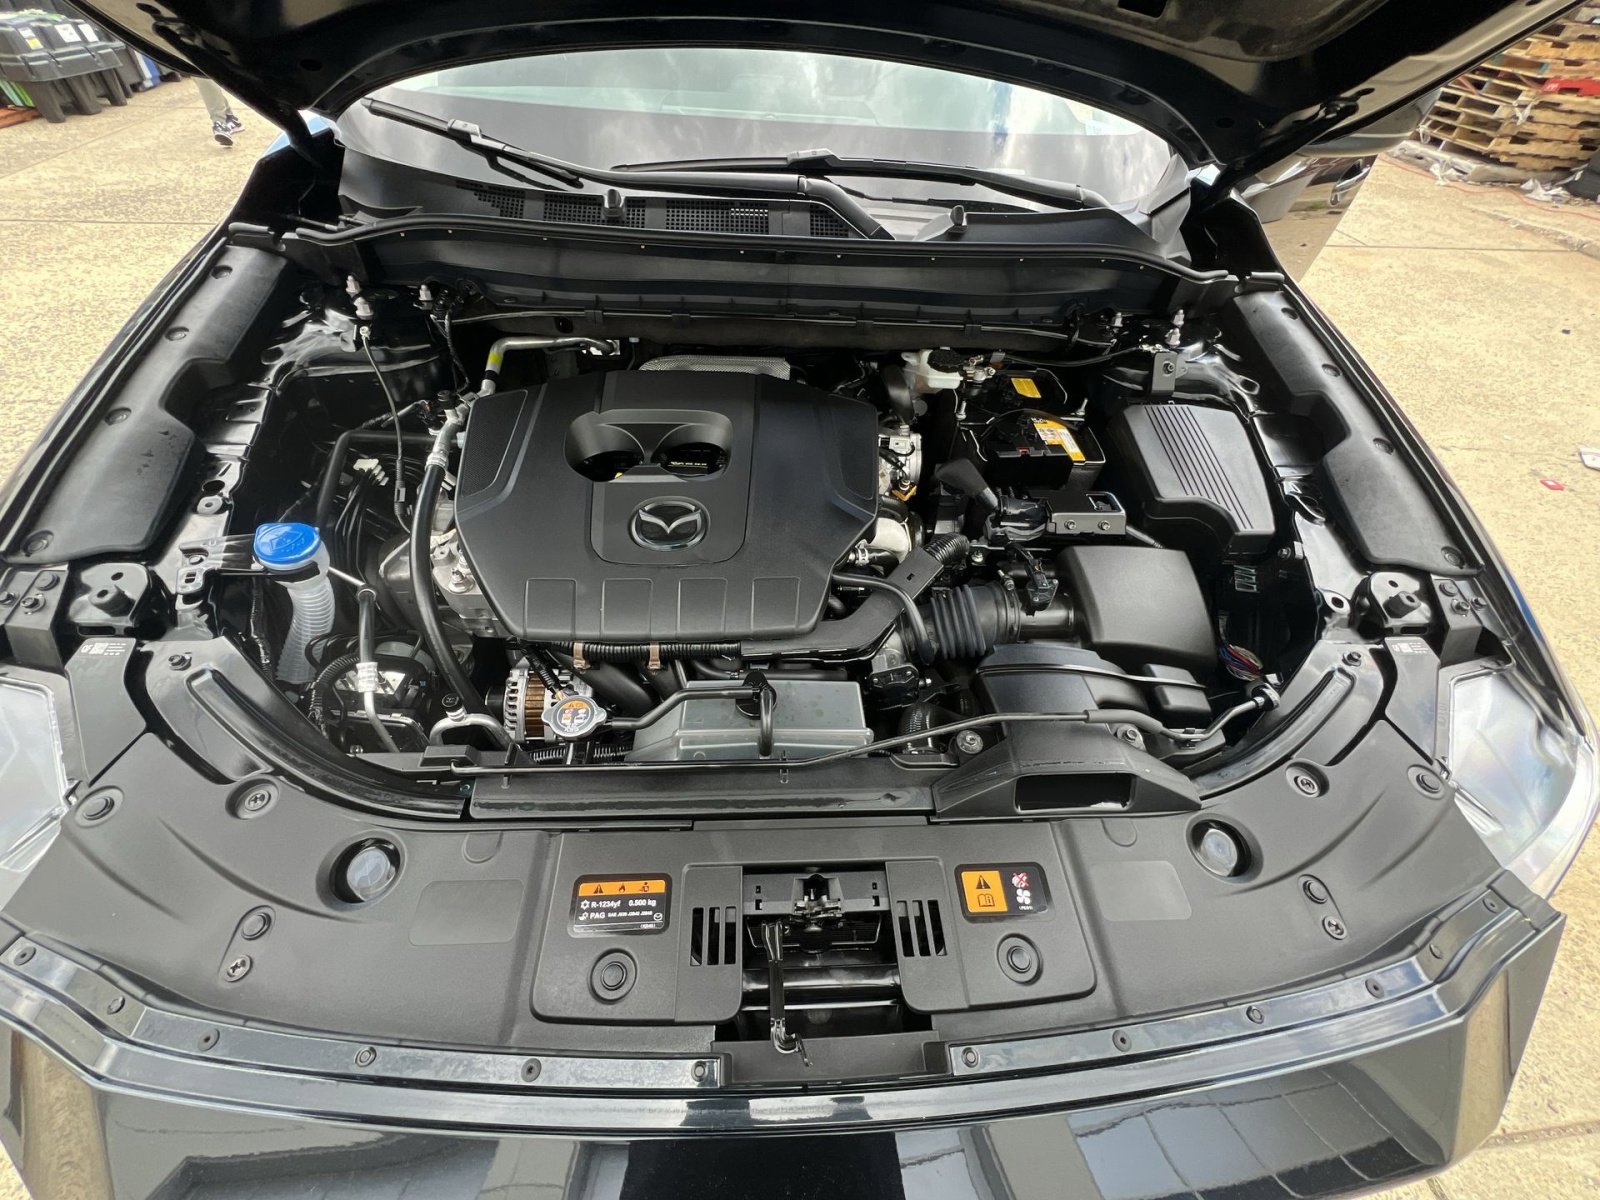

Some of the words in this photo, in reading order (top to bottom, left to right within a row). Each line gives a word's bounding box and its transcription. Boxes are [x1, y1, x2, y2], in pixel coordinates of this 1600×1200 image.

[590, 899, 621, 909] R-1234yf
[647, 898, 657, 907] kg
[590, 911, 606, 919] PAG
